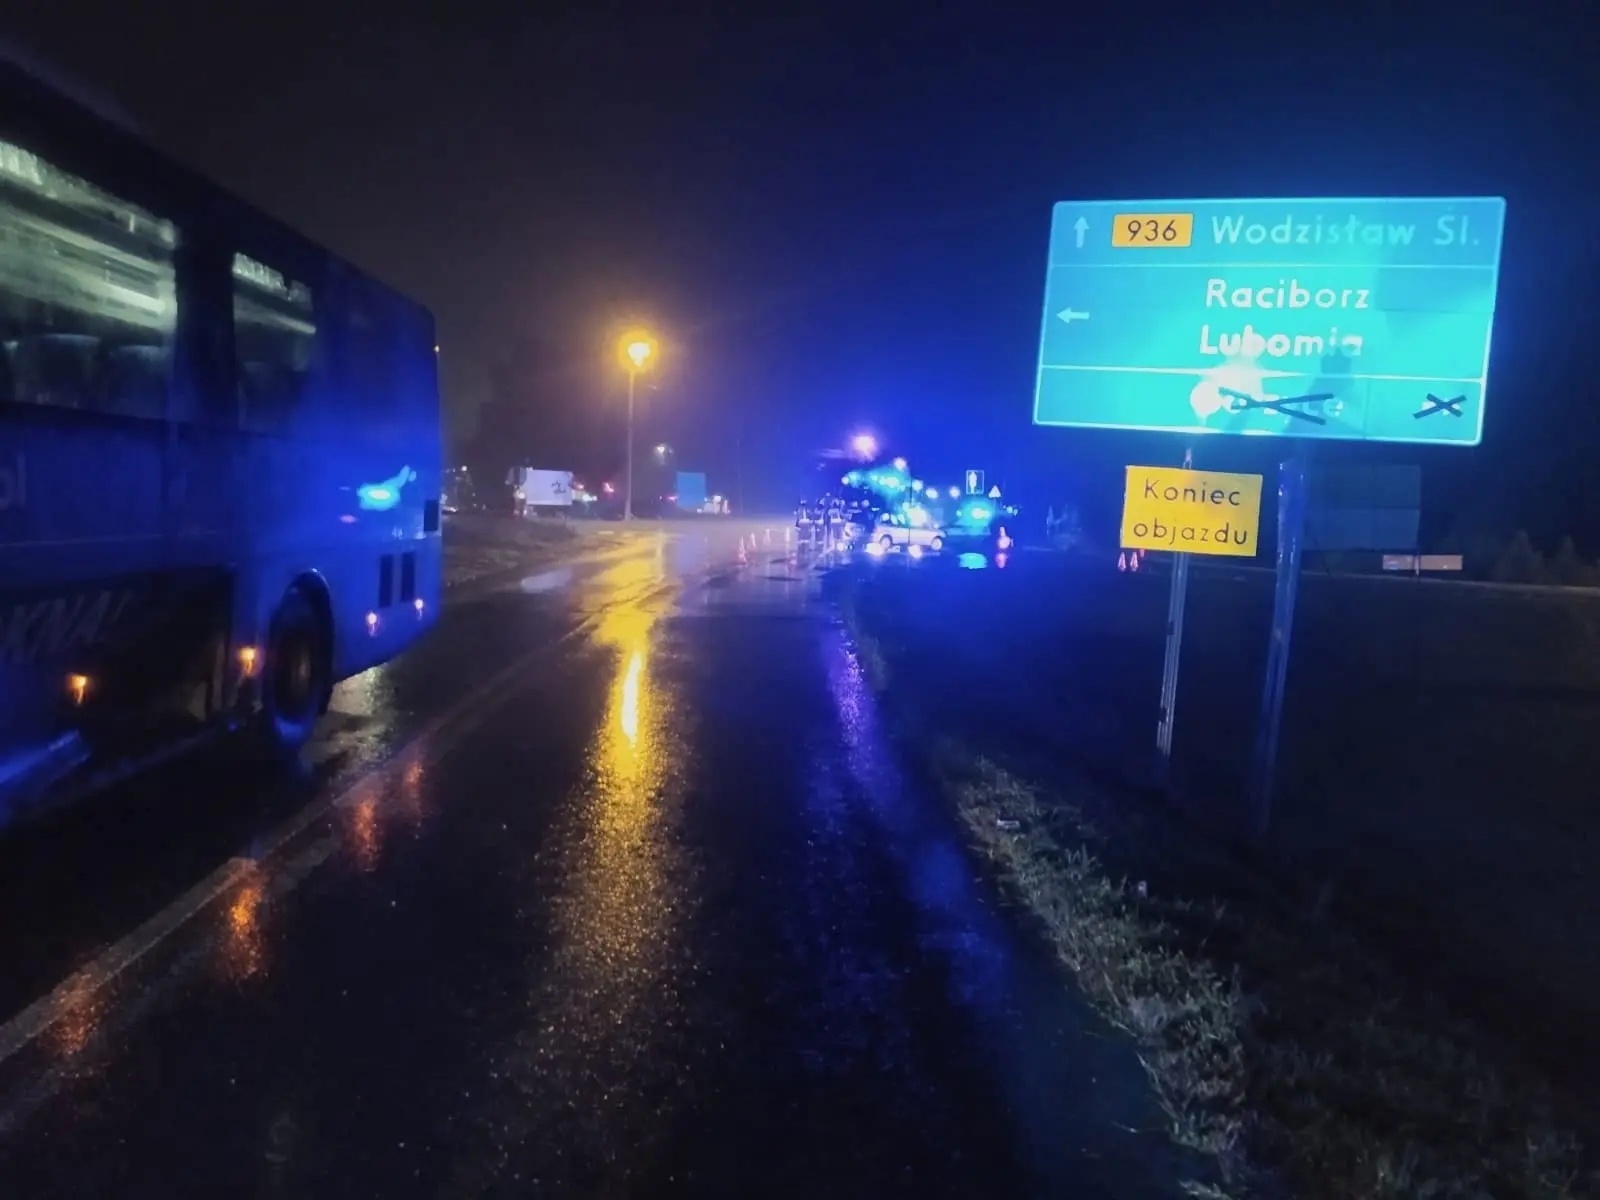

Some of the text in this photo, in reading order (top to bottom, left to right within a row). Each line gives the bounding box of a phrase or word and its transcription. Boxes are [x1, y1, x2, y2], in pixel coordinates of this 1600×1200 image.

[1126, 205, 1481, 247] 936 Wodzisław Śl.
[1199, 324, 1363, 357] Lubomia
[1144, 478, 1241, 506] Koniec
[1133, 517, 1248, 546] objazdu
